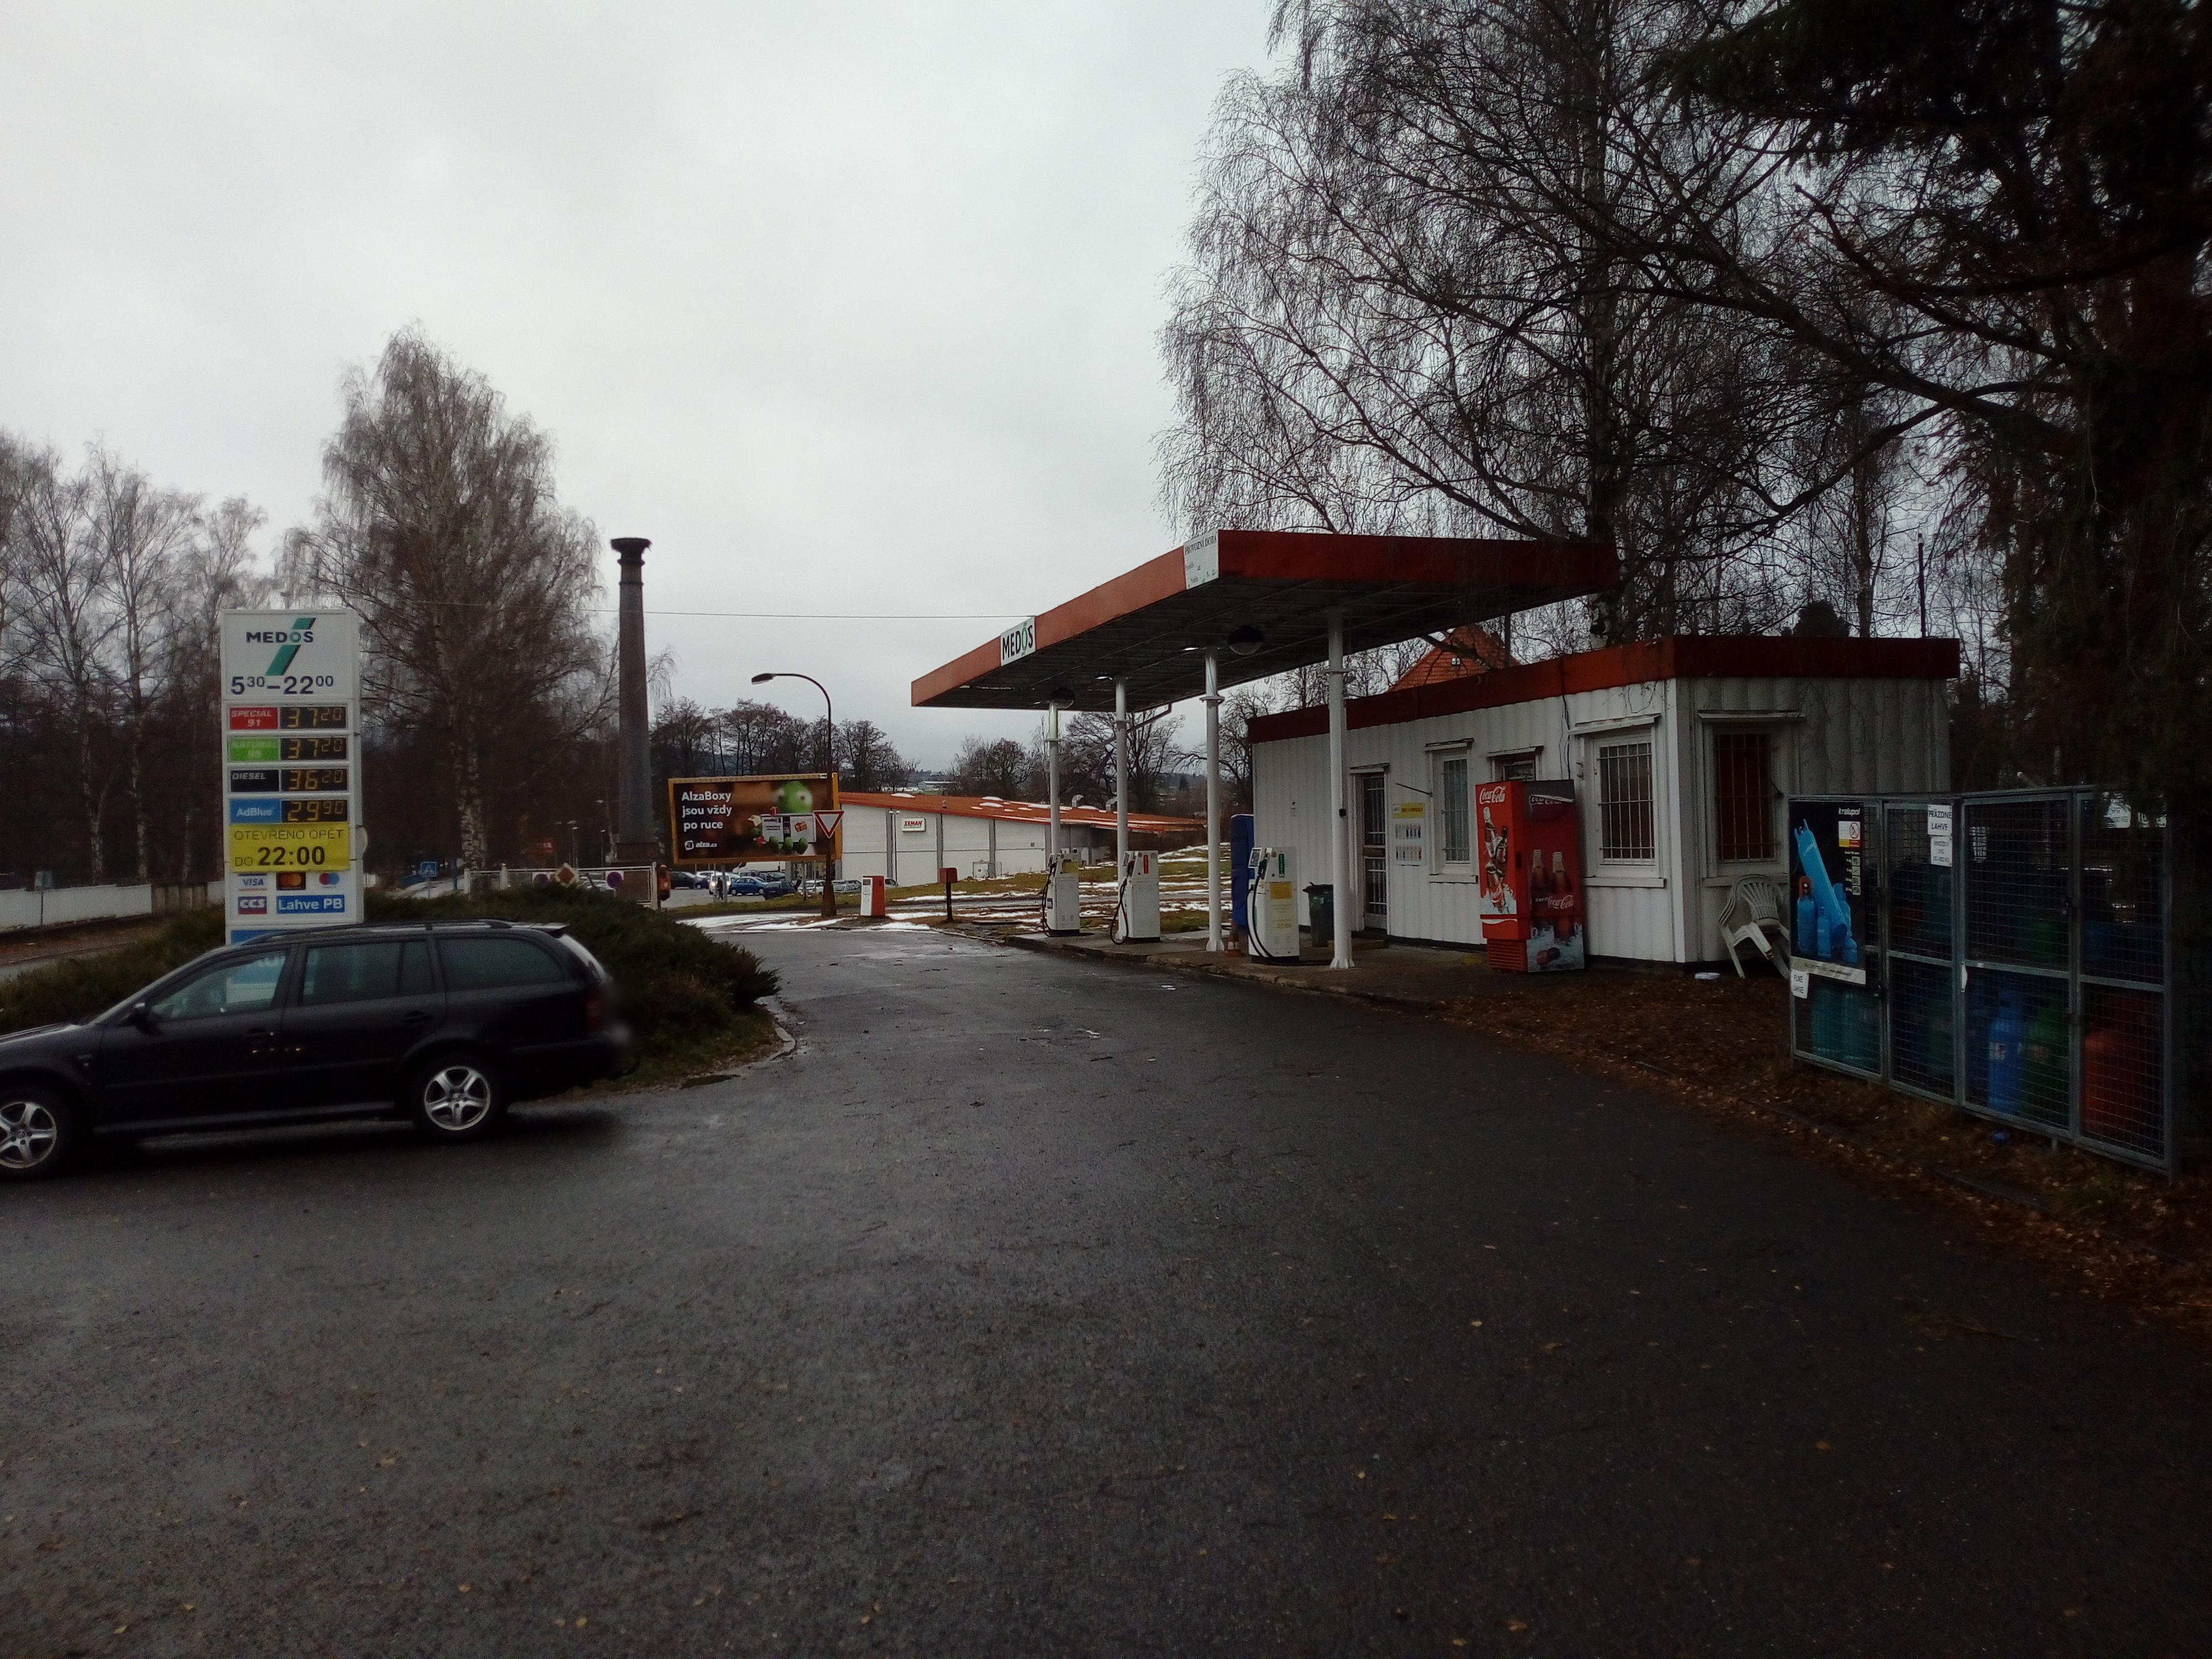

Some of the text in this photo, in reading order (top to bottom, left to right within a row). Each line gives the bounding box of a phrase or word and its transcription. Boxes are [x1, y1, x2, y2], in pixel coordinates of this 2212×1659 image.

[246, 632, 314, 643] MEDOS
[1003, 625, 1033, 660] MEDOS
[681, 791, 732, 802] AlzaBoxy
[236, 807, 273, 817] AdBlue
[682, 804, 732, 818] jsou vždy
[684, 822, 698, 832] po
[234, 846, 325, 867] DO 22:00
[239, 899, 266, 909] CCS
[278, 898, 343, 910] Lahve PB
